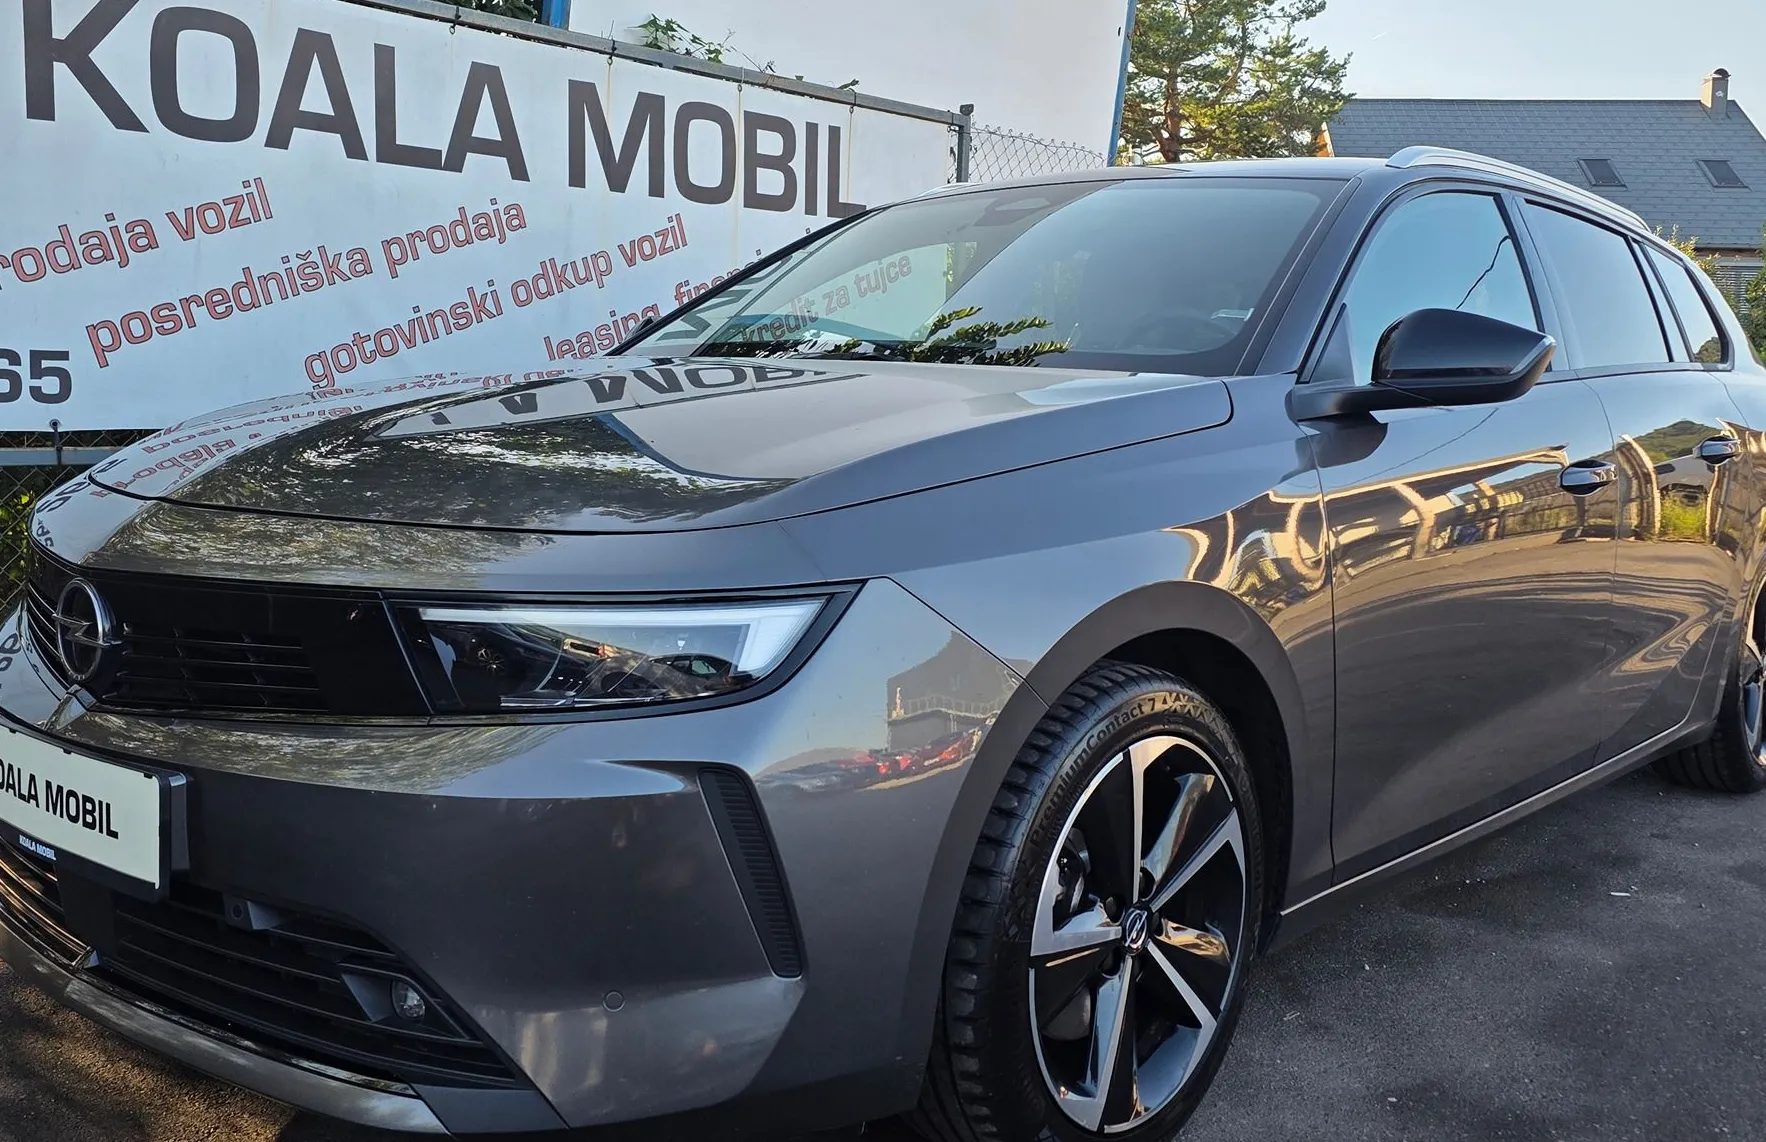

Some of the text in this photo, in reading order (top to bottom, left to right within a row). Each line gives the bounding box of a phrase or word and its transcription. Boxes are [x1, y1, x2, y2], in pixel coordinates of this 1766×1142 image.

[23, 0, 866, 218] KOALA MOBIL
[166, 177, 273, 243] vozil
[86, 198, 527, 368] posredniška prodaja
[304, 279, 503, 389] gotovinski
[510, 250, 613, 307] odkup
[617, 213, 688, 268] vozil
[822, 286, 850, 316] za
[853, 255, 912, 298] tujce
[45, 779, 119, 840] MOBIL
